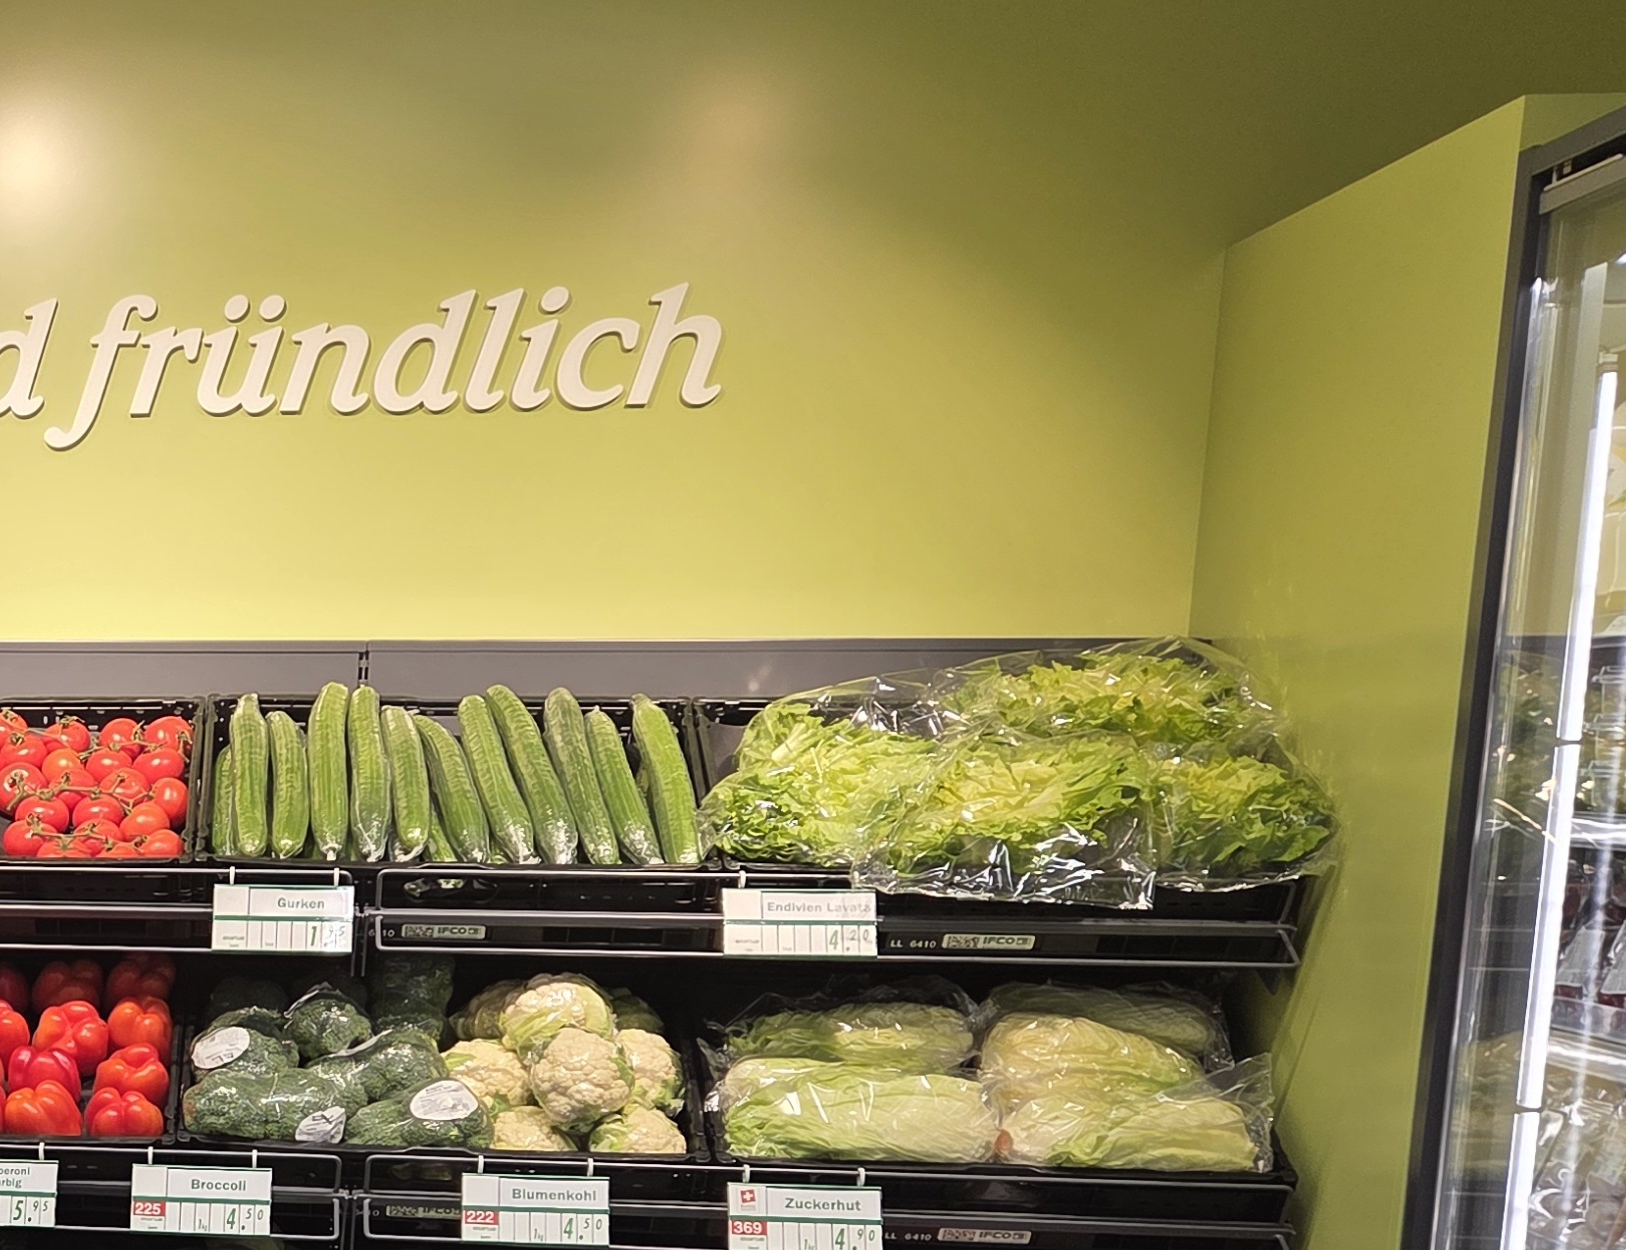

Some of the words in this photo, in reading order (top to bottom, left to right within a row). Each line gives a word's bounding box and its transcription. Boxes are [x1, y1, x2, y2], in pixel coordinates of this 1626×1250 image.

[43, 282, 722, 451] fründlich
[277, 898, 324, 909] Gurken
[767, 902, 822, 912] Endivien
[438, 927, 466, 935] IFCO
[890, 940, 902, 948] LL
[910, 939, 936, 948] 6410
[983, 937, 1015, 945] IFCO
[191, 1179, 246, 1191] Broccoli
[512, 1188, 596, 1201] Blumenkohl
[135, 1203, 161, 1215] 225
[785, 1198, 861, 1211] Zuckerhut
[13, 1200, 48, 1222] 5.95
[466, 1211, 494, 1223] 222
[226, 1208, 263, 1231] 4.50
[564, 1218, 602, 1240] 4.50
[733, 1221, 762, 1234] 369
[835, 1228, 875, 1250] 4.90
